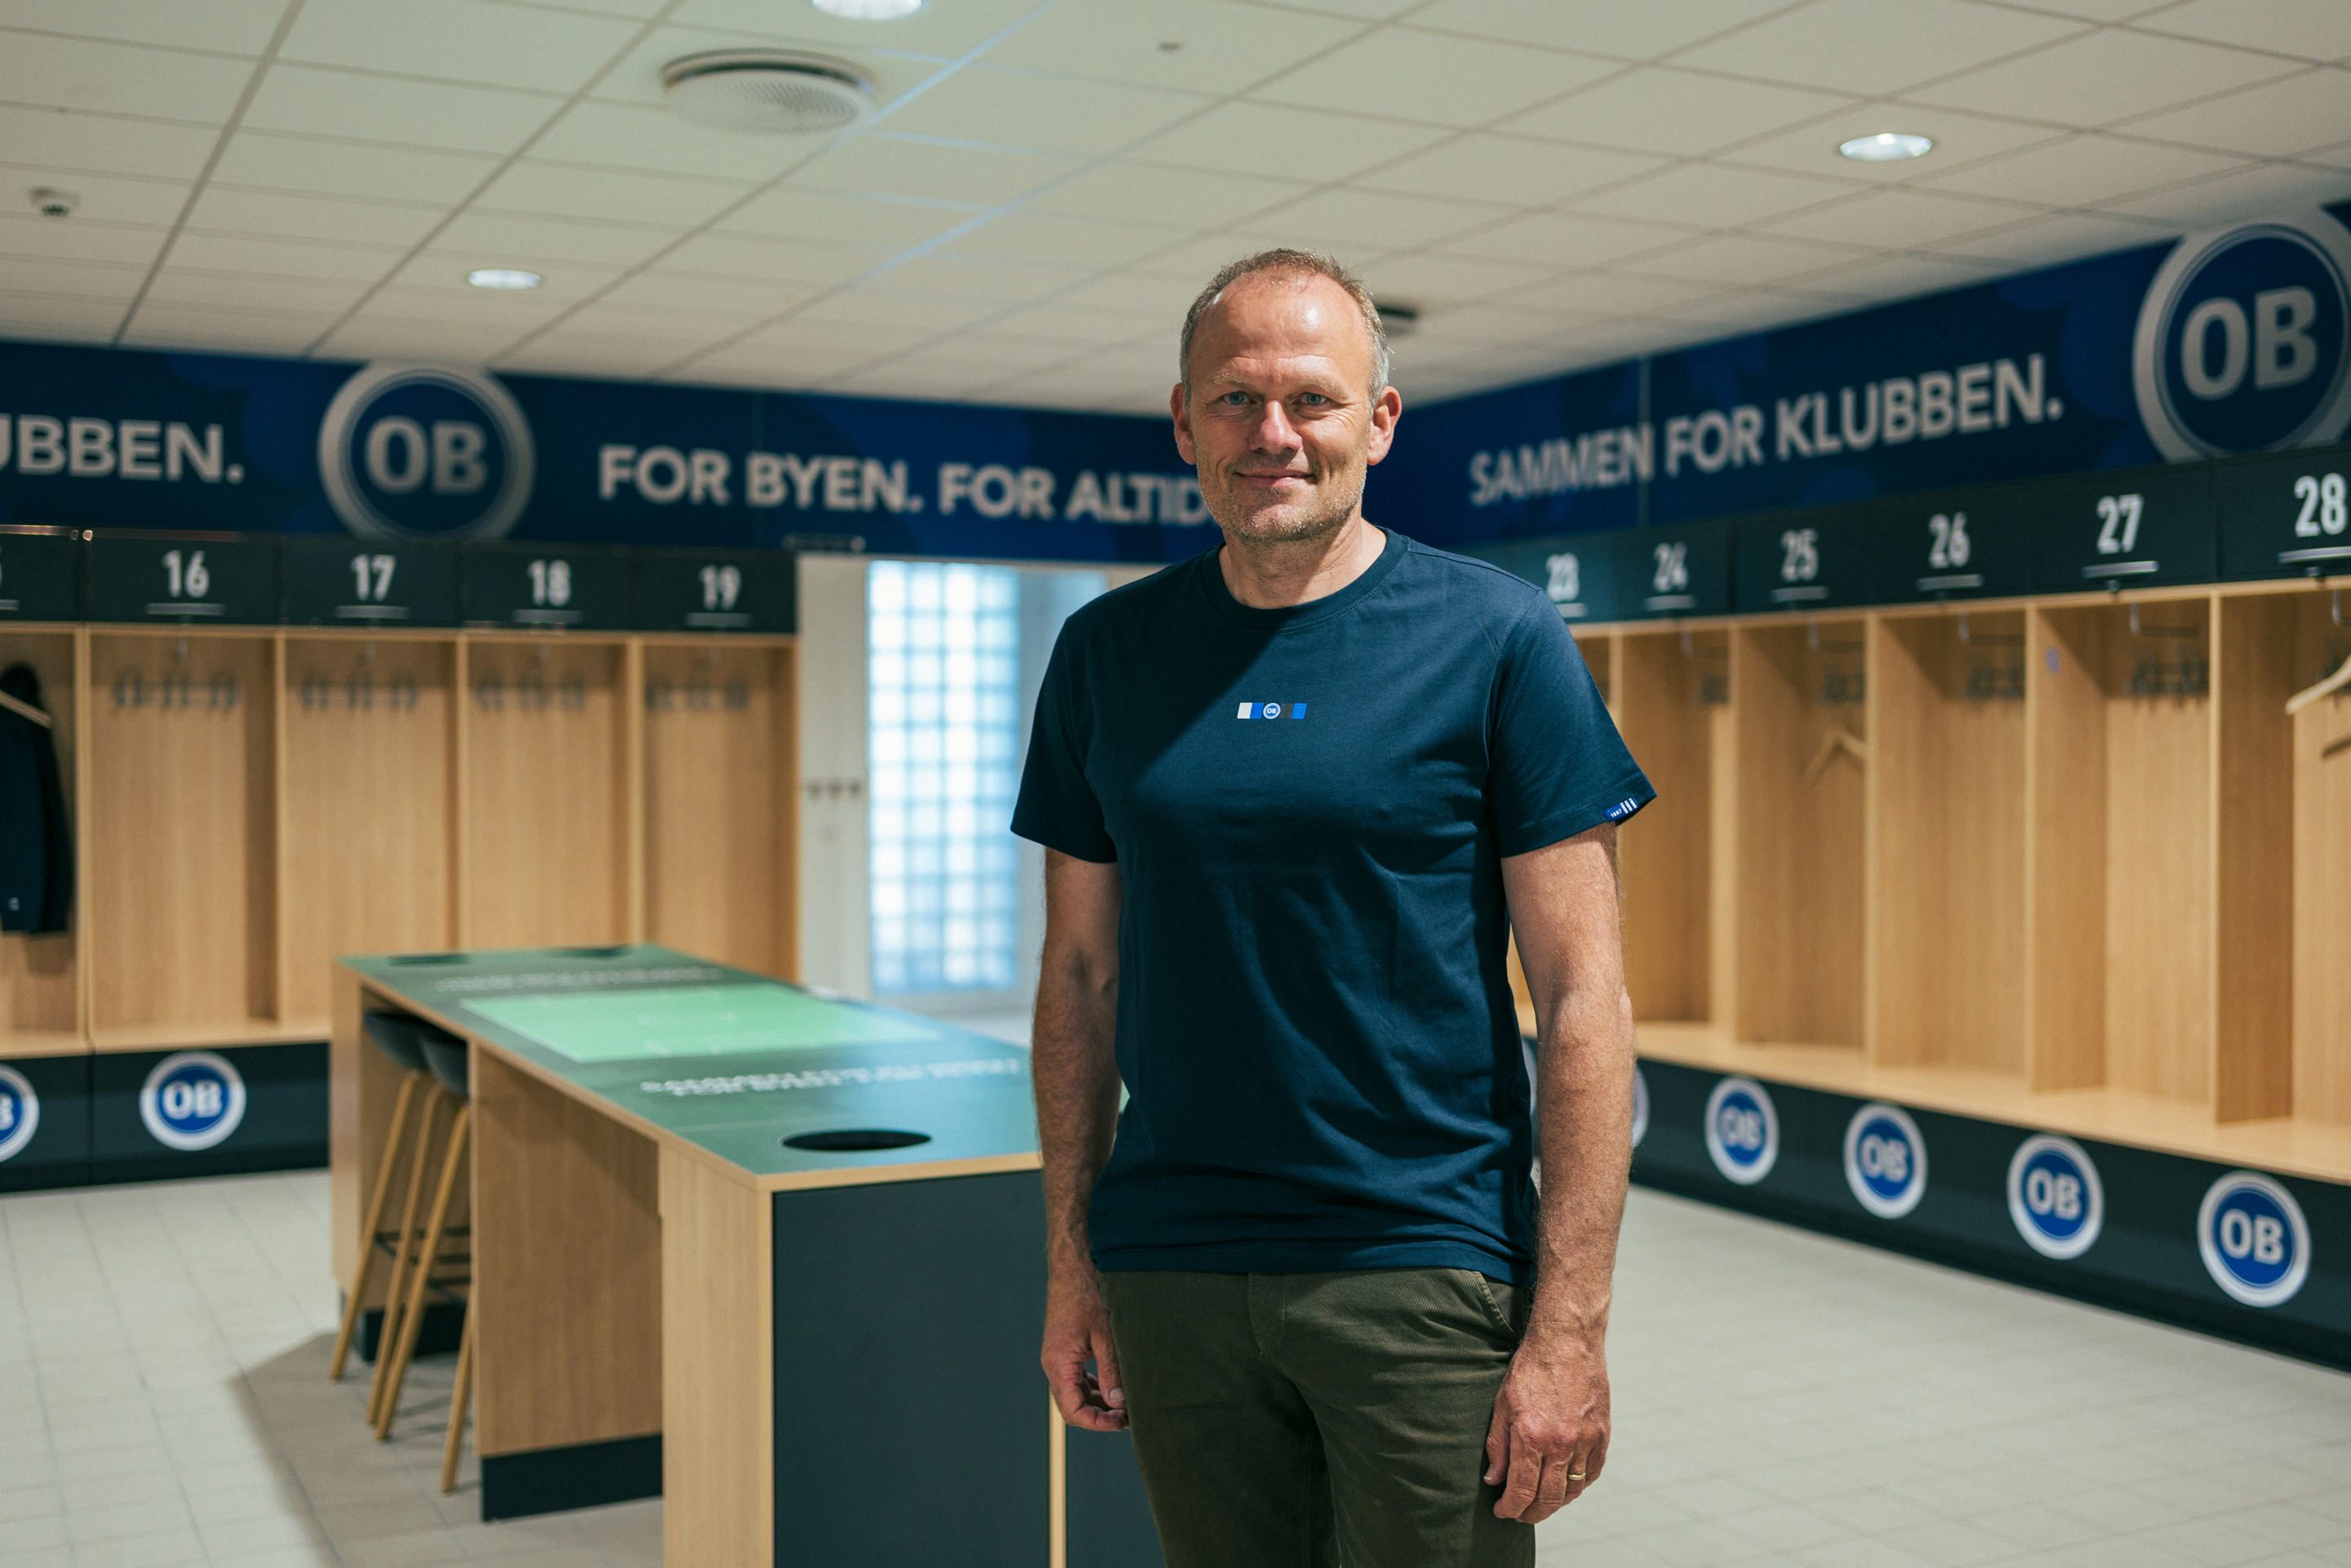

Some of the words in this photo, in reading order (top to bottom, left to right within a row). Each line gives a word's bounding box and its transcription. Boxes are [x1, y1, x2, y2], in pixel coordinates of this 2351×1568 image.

[2181, 287, 2317, 400] OB
[1664, 406, 1765, 478] FOR
[1775, 352, 2064, 461] KLUBBEN.
[0, 413, 244, 484] BBEN.
[365, 415, 489, 492] OB
[599, 444, 731, 504] FOR
[746, 451, 925, 513] BYEN.
[939, 464, 1056, 519] FOR
[2295, 473, 2348, 538] 28
[1930, 513, 1971, 568] 26
[2097, 493, 2144, 554] 27
[164, 550, 210, 598] 16
[351, 555, 397, 601] 17
[1780, 529, 1819, 582] 25
[528, 561, 571, 606] 18
[700, 566, 740, 611] 19
[162, 1082, 223, 1119] OB
[1720, 1104, 1763, 1151] OB
[1860, 1134, 1909, 1184] OB
[2024, 1167, 2082, 1222] OB
[2219, 1208, 2285, 1267] OB
